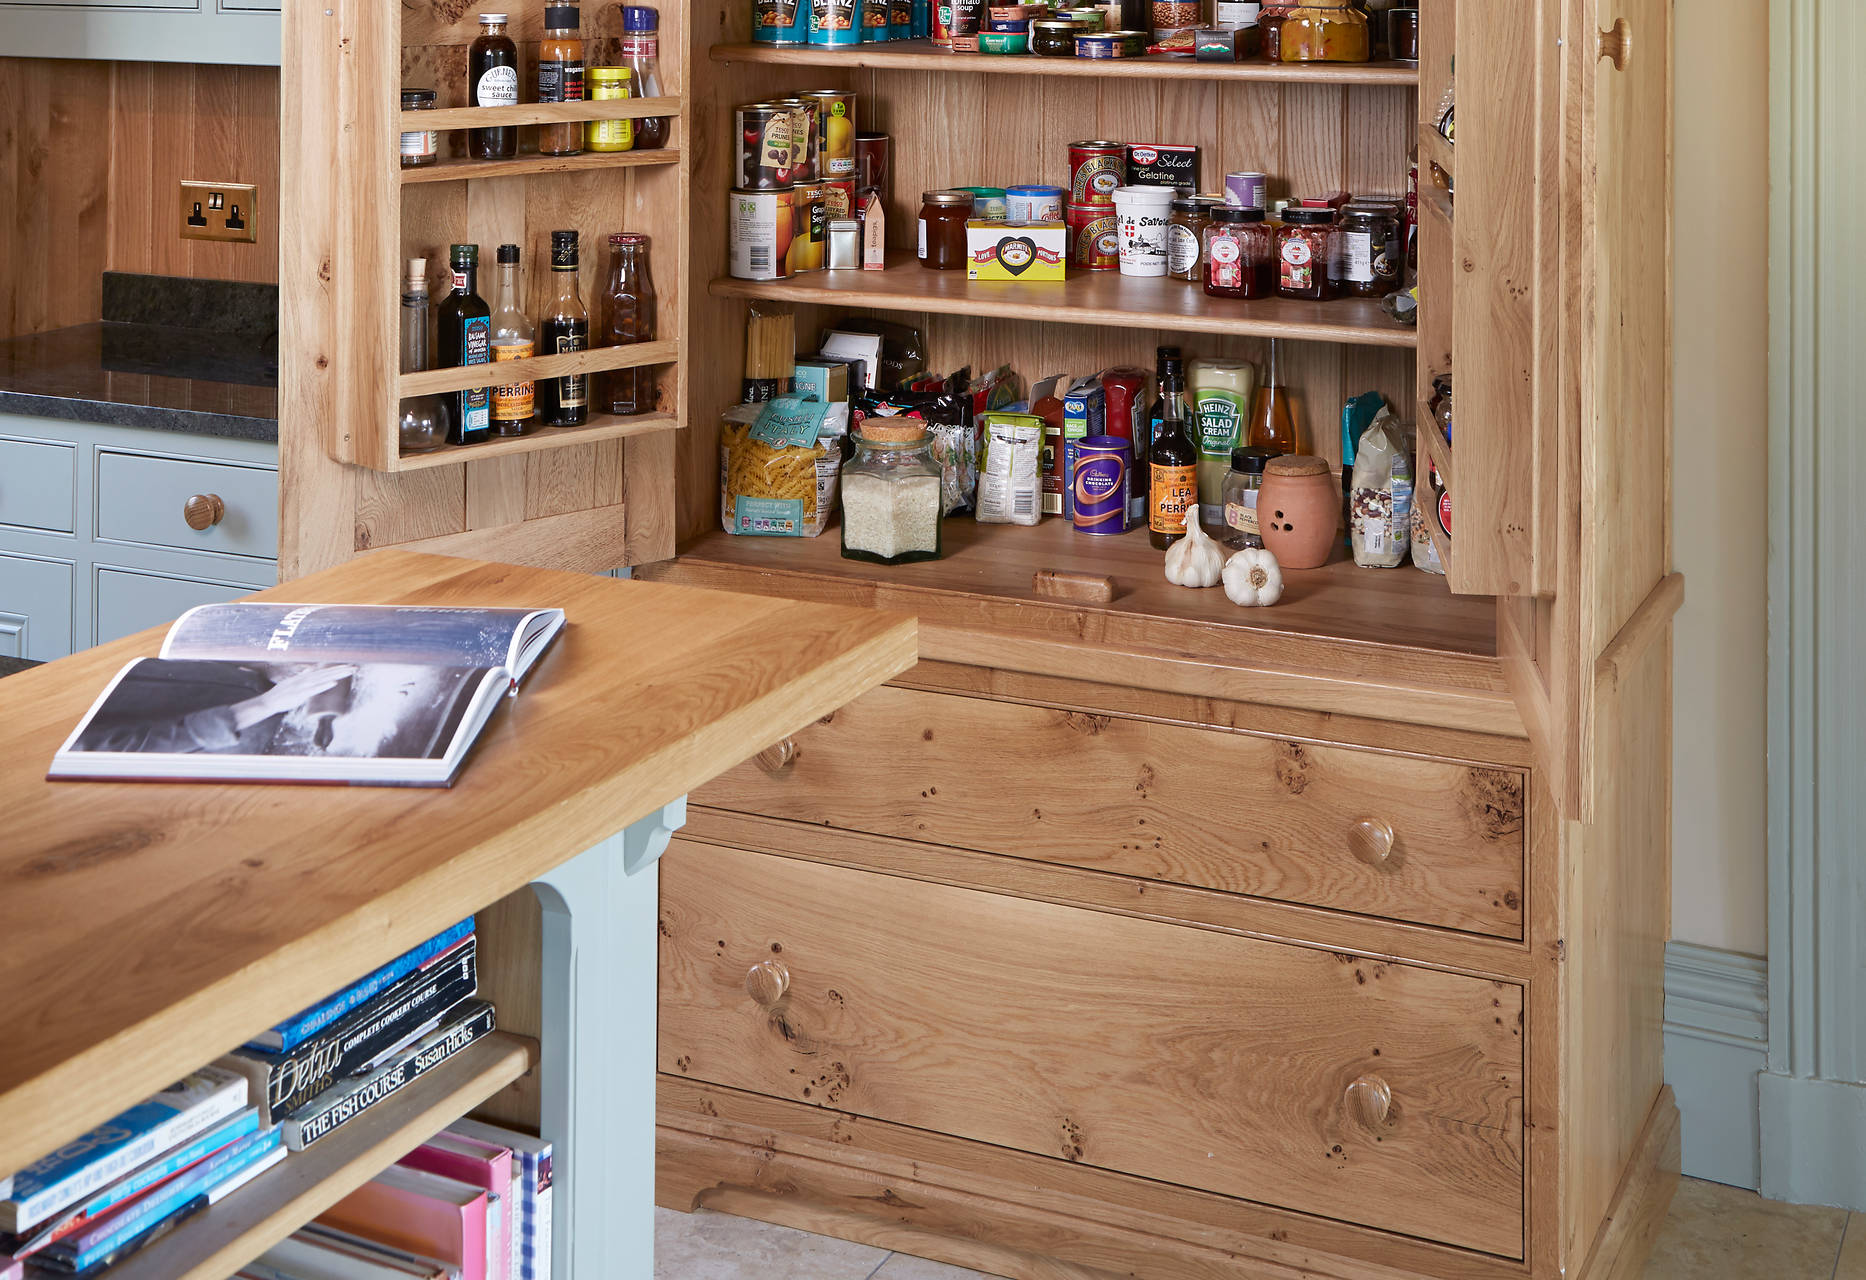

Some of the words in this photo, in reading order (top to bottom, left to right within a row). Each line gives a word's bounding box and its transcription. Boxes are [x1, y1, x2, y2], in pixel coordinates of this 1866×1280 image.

[956, 5, 975, 14] soup
[481, 84, 505, 93] sweet
[491, 91, 513, 99] sauce
[771, 132, 790, 141] PRUNE
[1085, 157, 1116, 172] BLACK
[1156, 153, 1193, 169] Select
[1138, 170, 1175, 182] Gelatine
[1138, 216, 1169, 227] Savoie
[1004, 243, 1029, 253] MARMITE
[492, 382, 535, 398] PERRINS
[794, 382, 817, 391] AGNE
[1202, 403, 1231, 415] HEINZ
[1200, 416, 1233, 429] SALAD
[764, 422, 810, 436] ITALY
[1202, 426, 1231, 438] CREAM
[1201, 435, 1232, 448] Original
[1172, 487, 1192, 498] LEA
[1160, 503, 1190, 514] PERR
[1229, 508, 1239, 526] B
[342, 1020, 382, 1053] COMPLETE
[379, 1001, 413, 1027] COOKERY
[411, 982, 438, 1008] COURSE
[302, 1117, 331, 1144] THE
[331, 1097, 359, 1130] FISH
[358, 1066, 406, 1114] COURSE
[414, 1047, 446, 1075] Susan
[445, 1026, 474, 1059] Hicks
